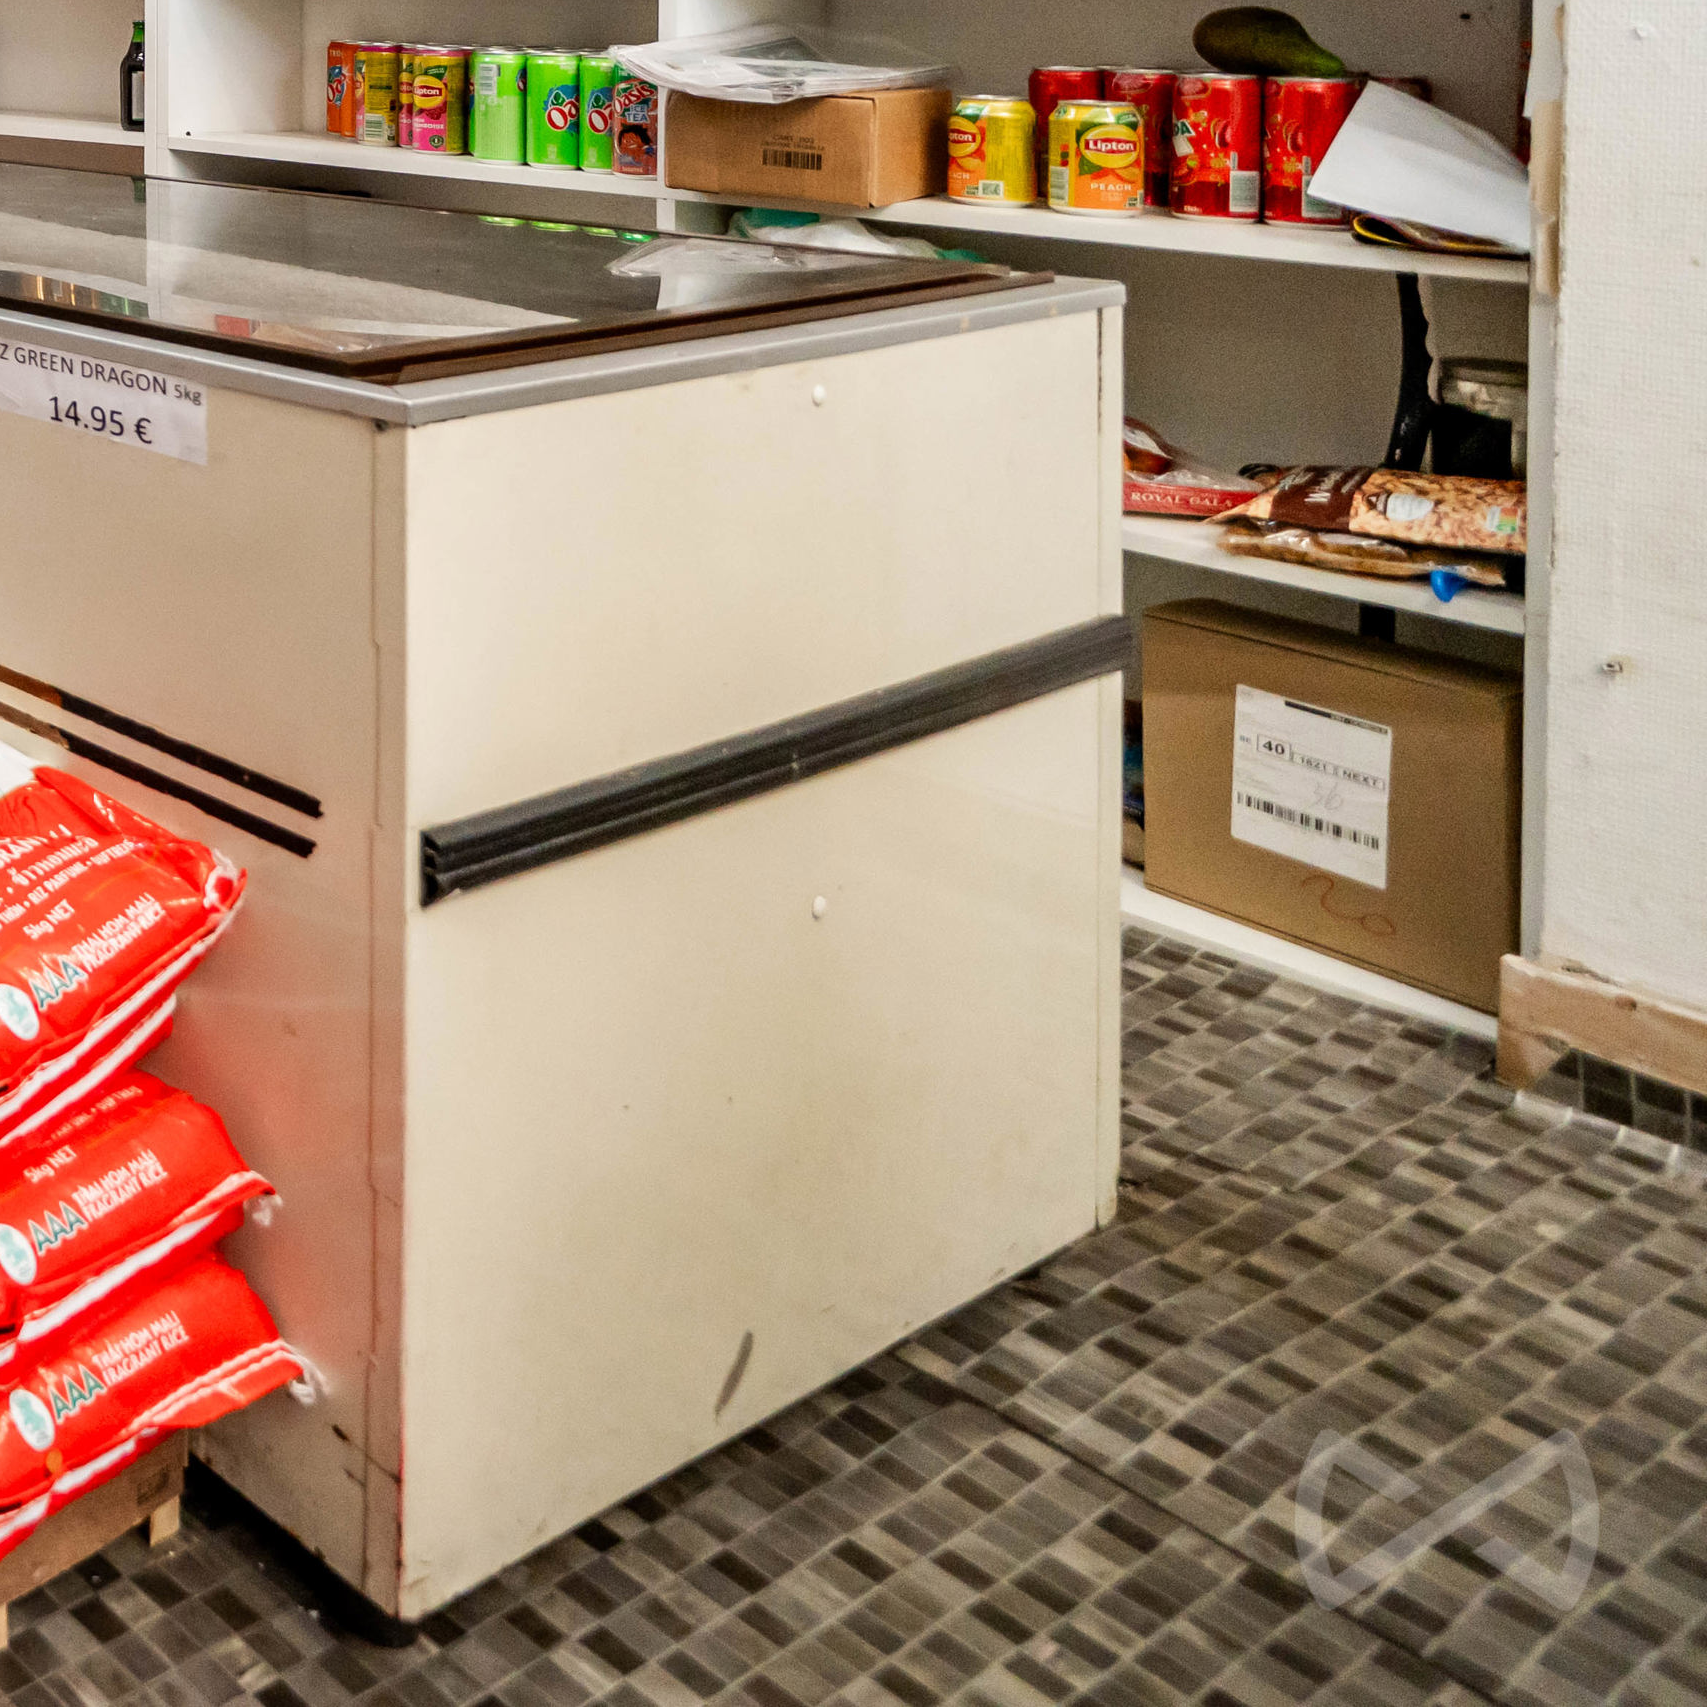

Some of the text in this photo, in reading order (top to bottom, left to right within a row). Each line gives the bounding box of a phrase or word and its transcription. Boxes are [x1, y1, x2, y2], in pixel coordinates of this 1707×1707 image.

[1088, 139, 1135, 152] Lipton
[1090, 182, 1133, 191] PEACH
[13, 350, 74, 376] GREEN
[81, 363, 168, 396] DRAGON
[173, 385, 203, 406] 5kg
[48, 396, 154, 445] 14.95 €
[1131, 492, 1233, 507] ROYAL GALA
[1263, 740, 1285, 755] 40
[1342, 770, 1377, 786] NEXT
[46, 898, 76, 930] NET
[47, 1363, 109, 1424] AAA
